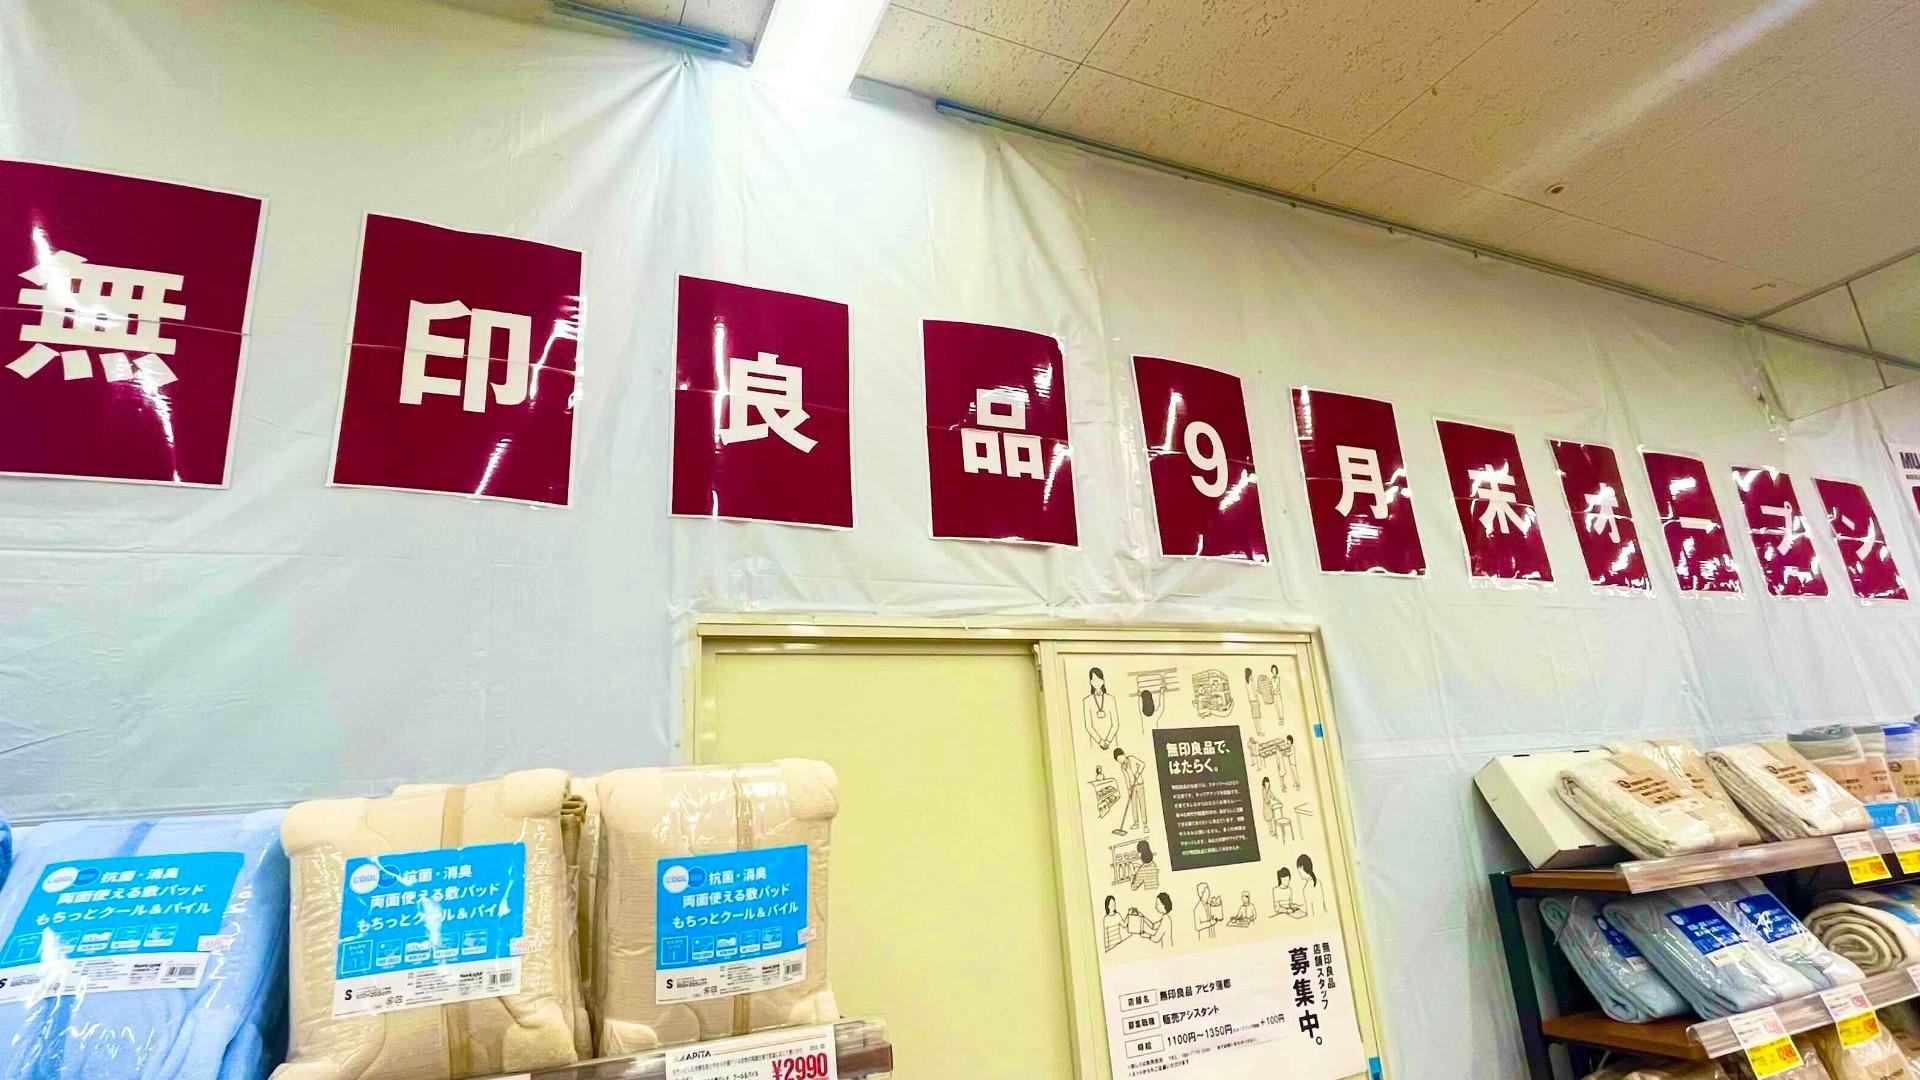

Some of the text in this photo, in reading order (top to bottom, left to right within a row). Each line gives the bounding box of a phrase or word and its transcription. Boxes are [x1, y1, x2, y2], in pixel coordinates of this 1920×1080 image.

[1166, 740, 1231, 757] 無印良品で、
[1169, 758, 1219, 775] はたらく。
[708, 866, 767, 886] 抗菌・消臭
[1321, 942, 1336, 989] 無印良品
[666, 978, 673, 989] S
[1313, 944, 1328, 1010] 店舗スタッフ
[344, 989, 352, 1000] S
[1127, 995, 1150, 1007] 店舗名
[1160, 986, 1193, 1001] 無印良品
[1288, 947, 1323, 1046] 募集中。
[1162, 1004, 1220, 1025] 販売アシスタント
[771, 1053, 829, 1080] ¥2990
